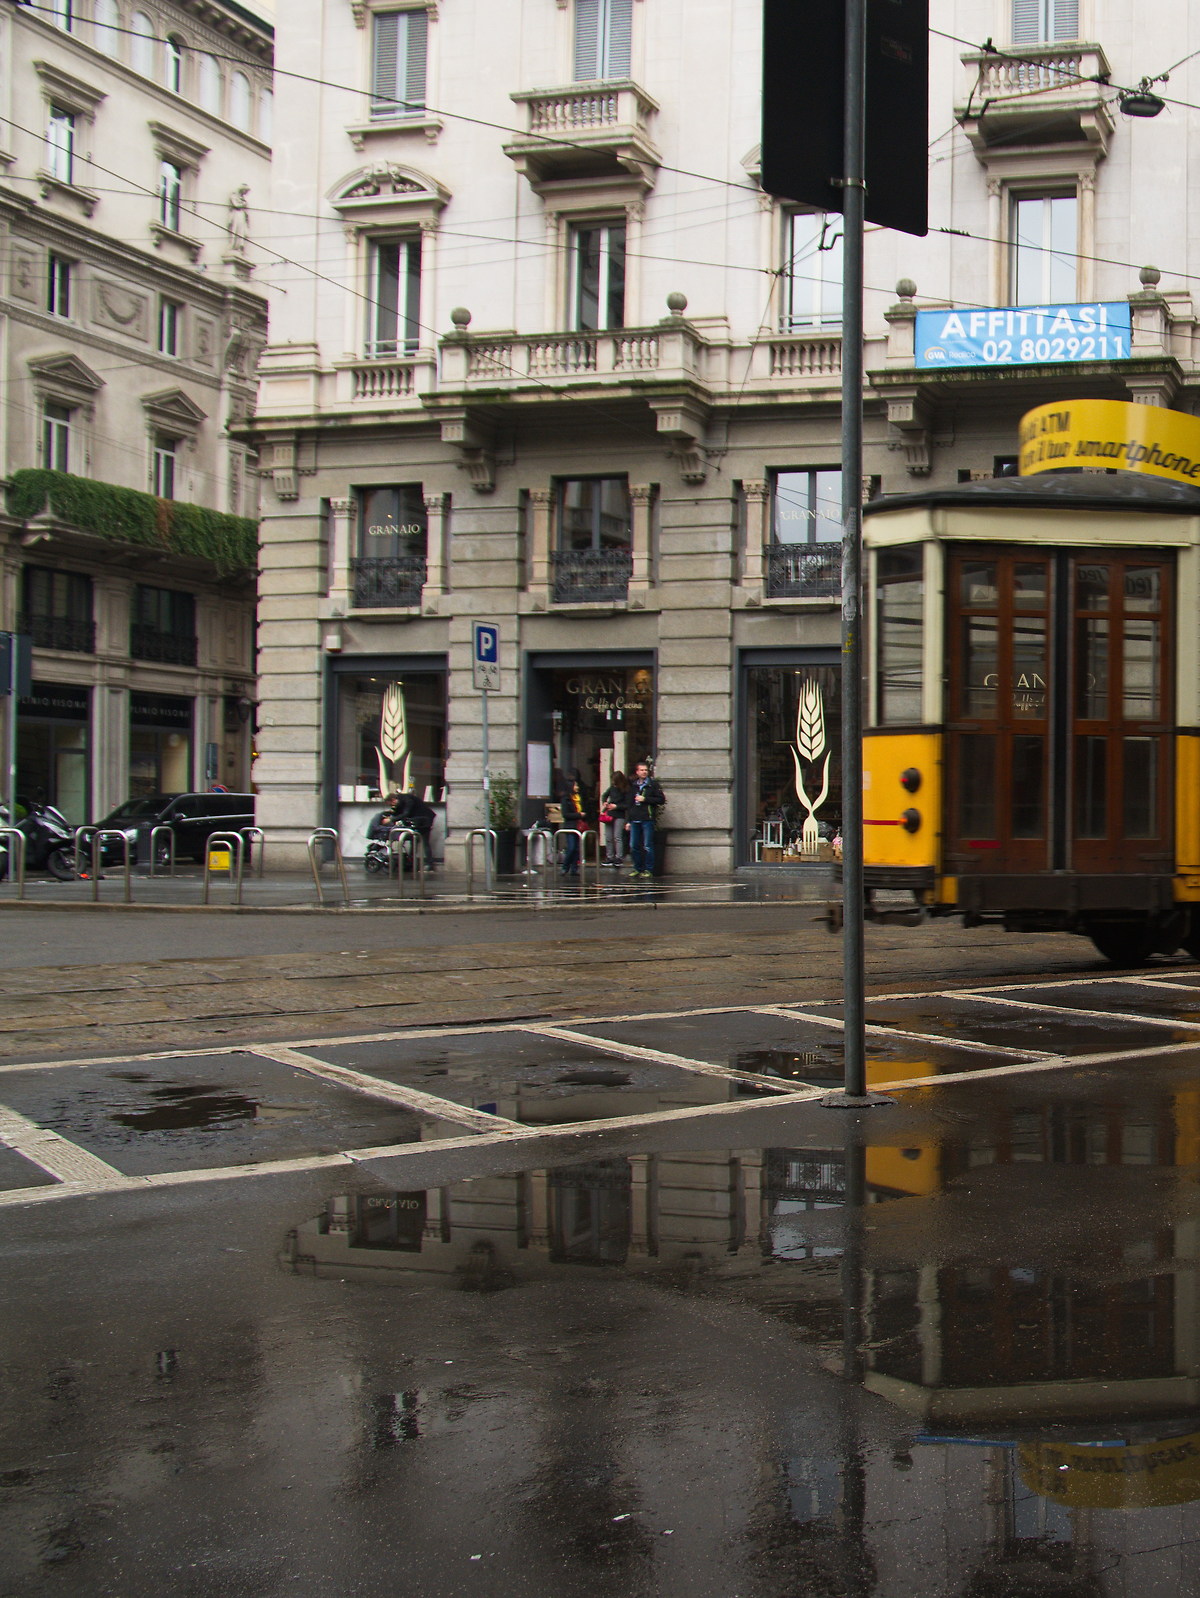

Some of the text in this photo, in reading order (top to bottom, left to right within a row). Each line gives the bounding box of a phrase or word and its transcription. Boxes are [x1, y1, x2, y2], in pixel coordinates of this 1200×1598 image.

[941, 307, 1107, 338] AFFITTASI
[928, 351, 946, 361] GVA
[983, 337, 1123, 362] 02 8029211
[368, 524, 420, 536] GRANAIO
[481, 632, 493, 656] P
[616, 696, 643, 710] Cucina
